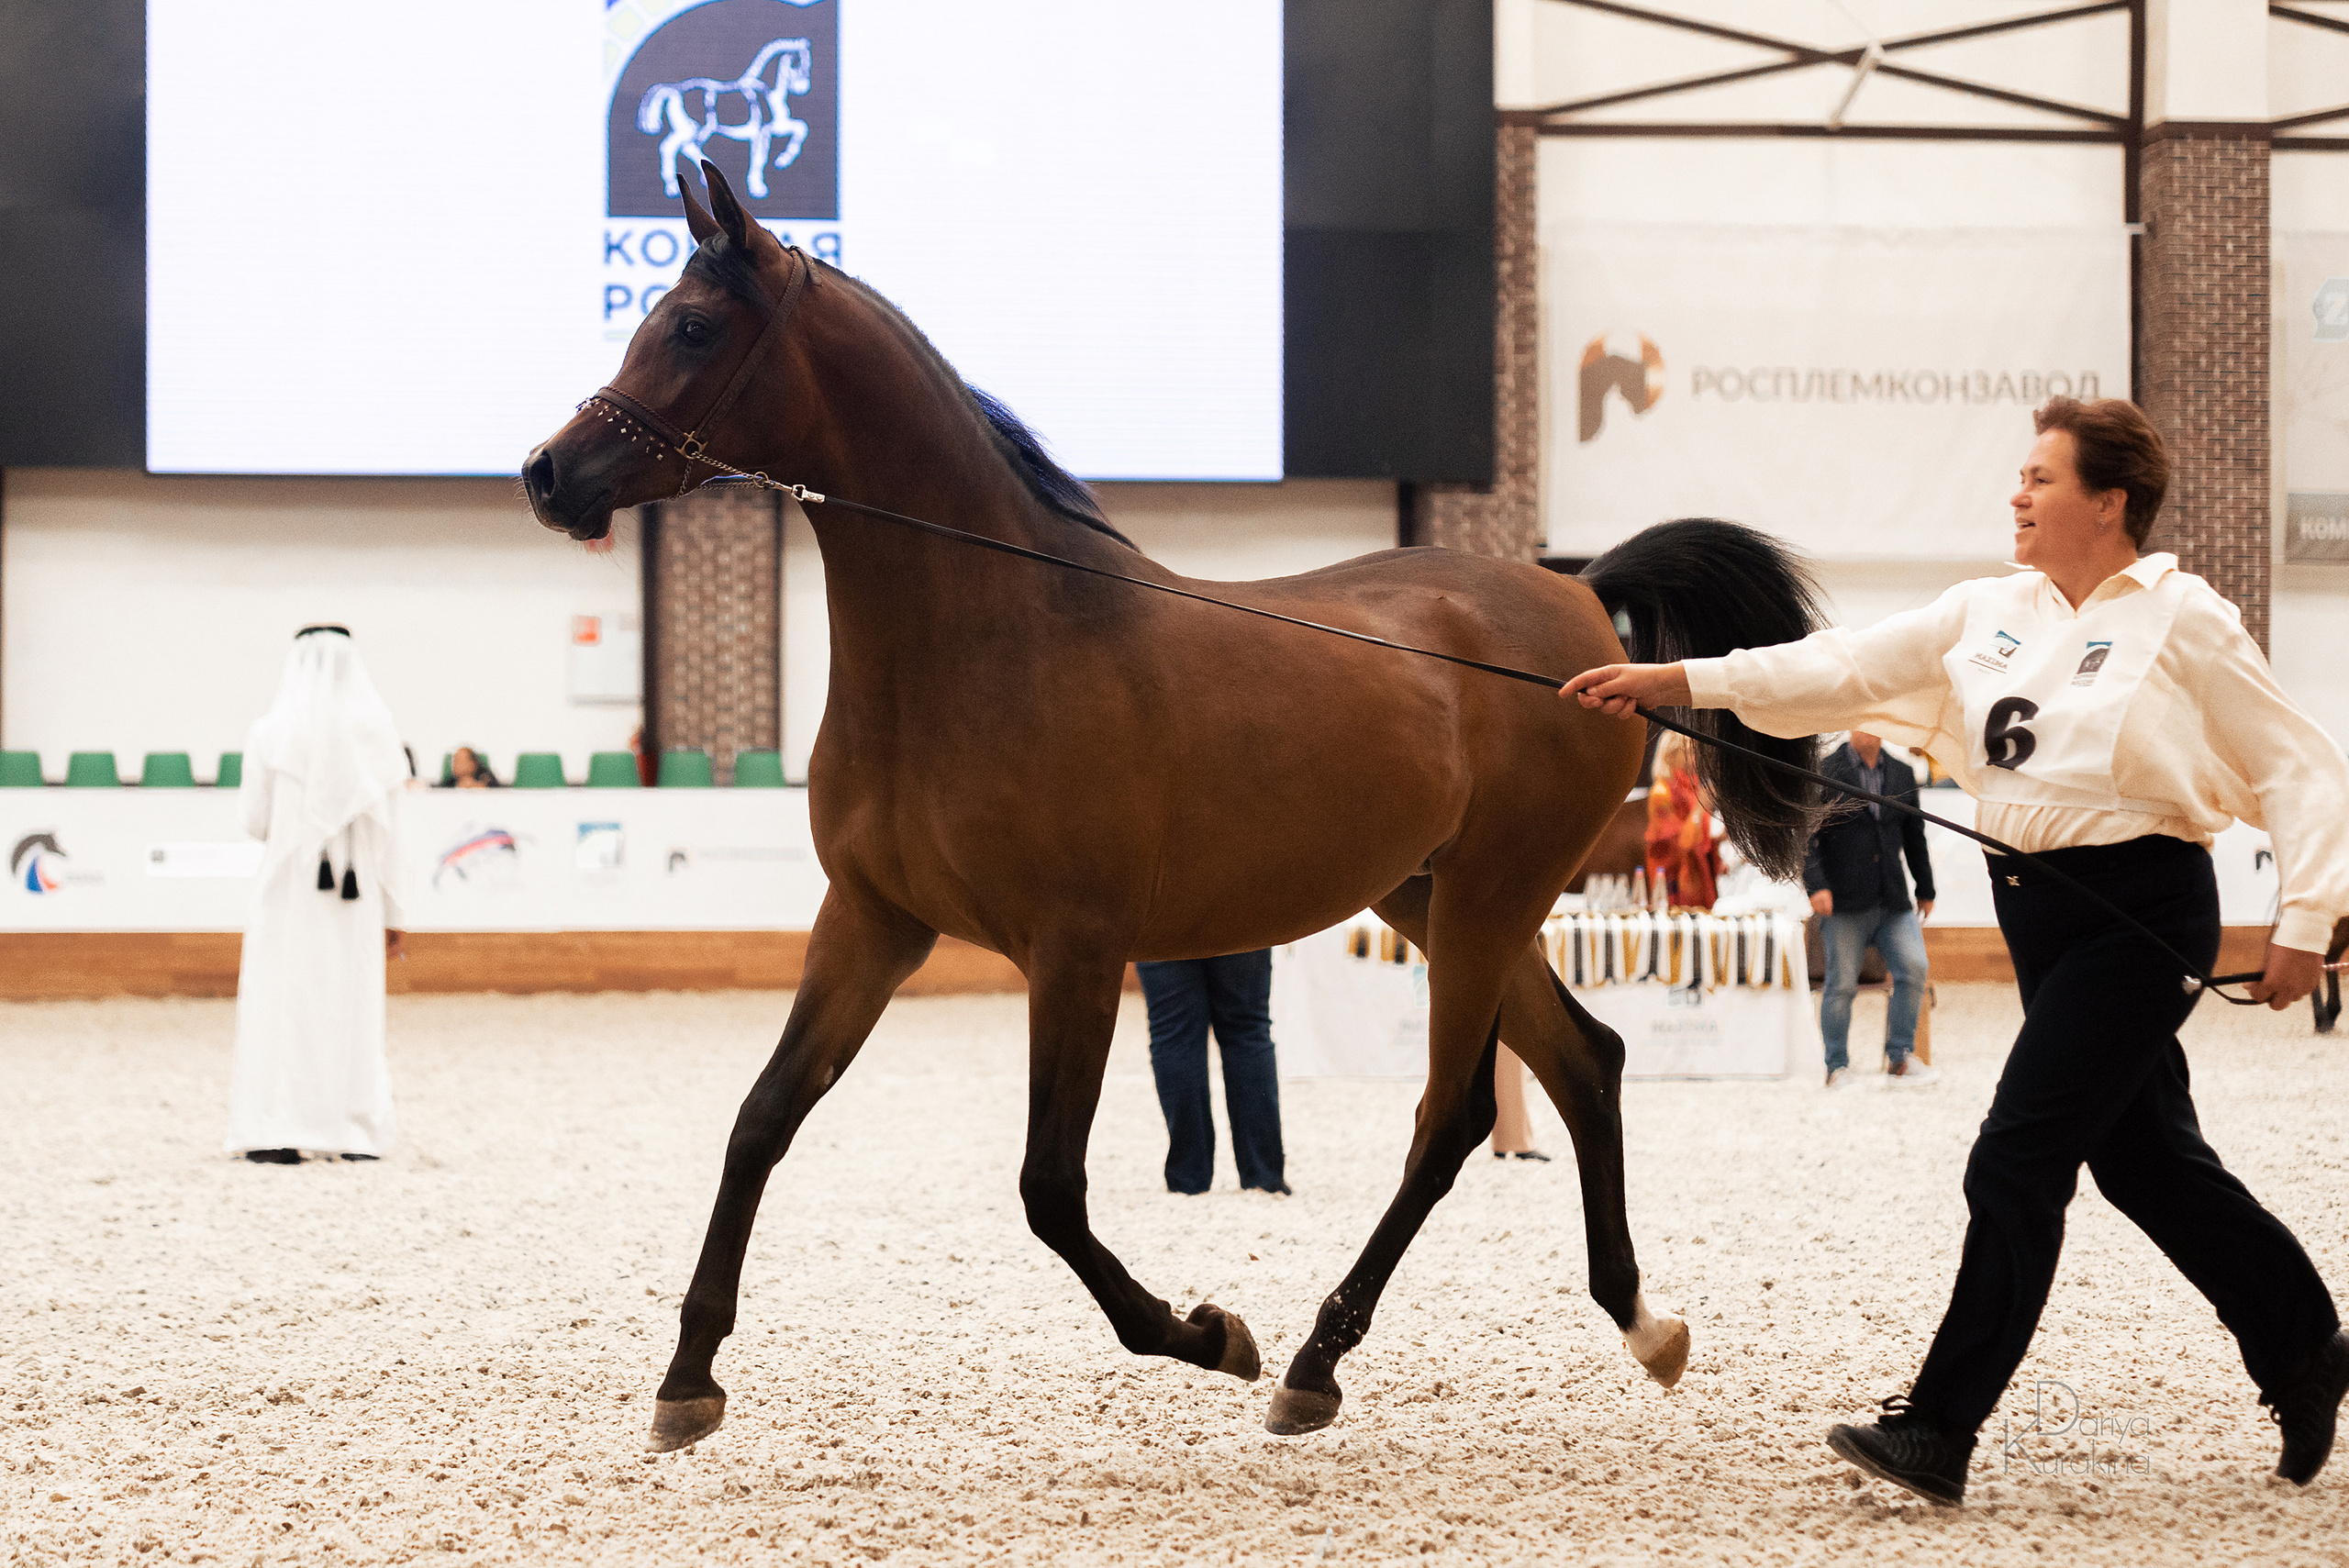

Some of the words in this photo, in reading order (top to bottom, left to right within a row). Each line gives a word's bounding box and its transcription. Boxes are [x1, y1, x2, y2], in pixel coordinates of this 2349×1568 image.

[604, 229, 841, 268] КОЯ
[1690, 365, 2100, 405] РОСПЛЕМКОНЗАВОД
[1984, 696, 2040, 771] 6
